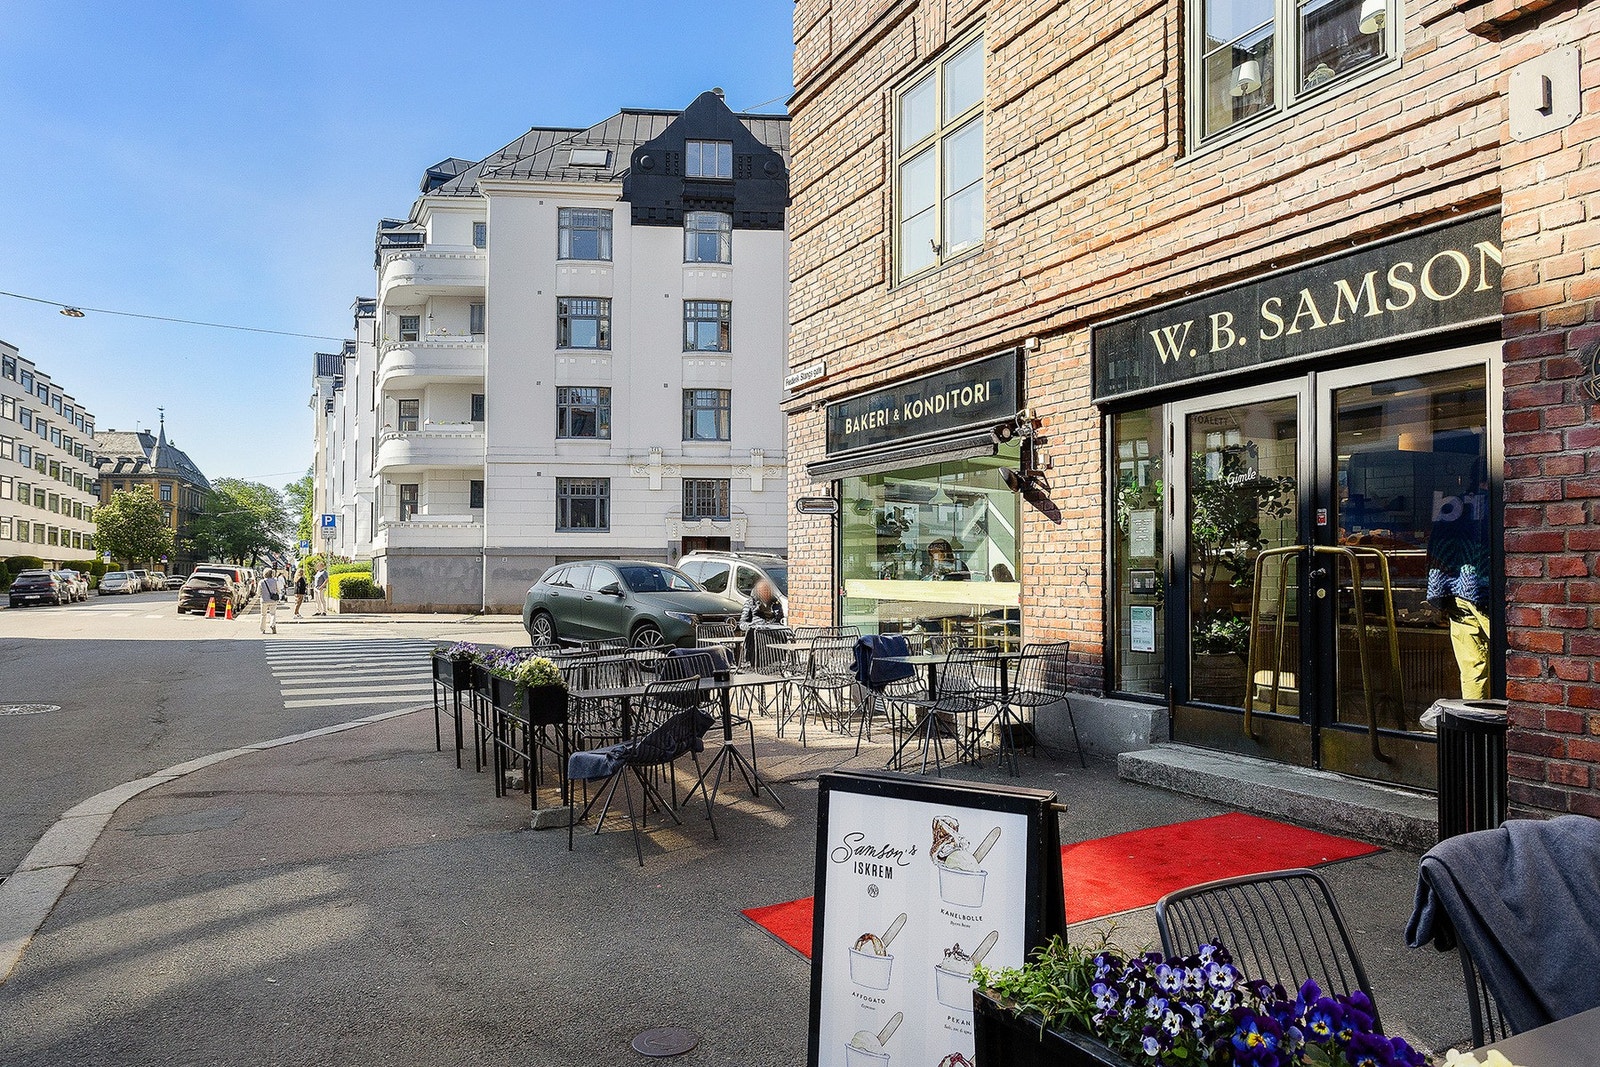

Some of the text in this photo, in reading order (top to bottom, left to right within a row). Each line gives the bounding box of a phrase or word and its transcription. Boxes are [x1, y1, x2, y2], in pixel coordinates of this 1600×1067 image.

[1149, 241, 1502, 365] W. B. SAMSON
[845, 381, 990, 434] BAKERI & KONDITORI
[1227, 466, 1257, 488] Gimle
[324, 515, 333, 525] P
[831, 832, 918, 867] Samson's
[853, 860, 893, 880] ISKREM
[940, 908, 983, 922] KANELBOLLE
[851, 991, 886, 1005] AFFOGATO
[947, 1015, 971, 1026] PEKAN
